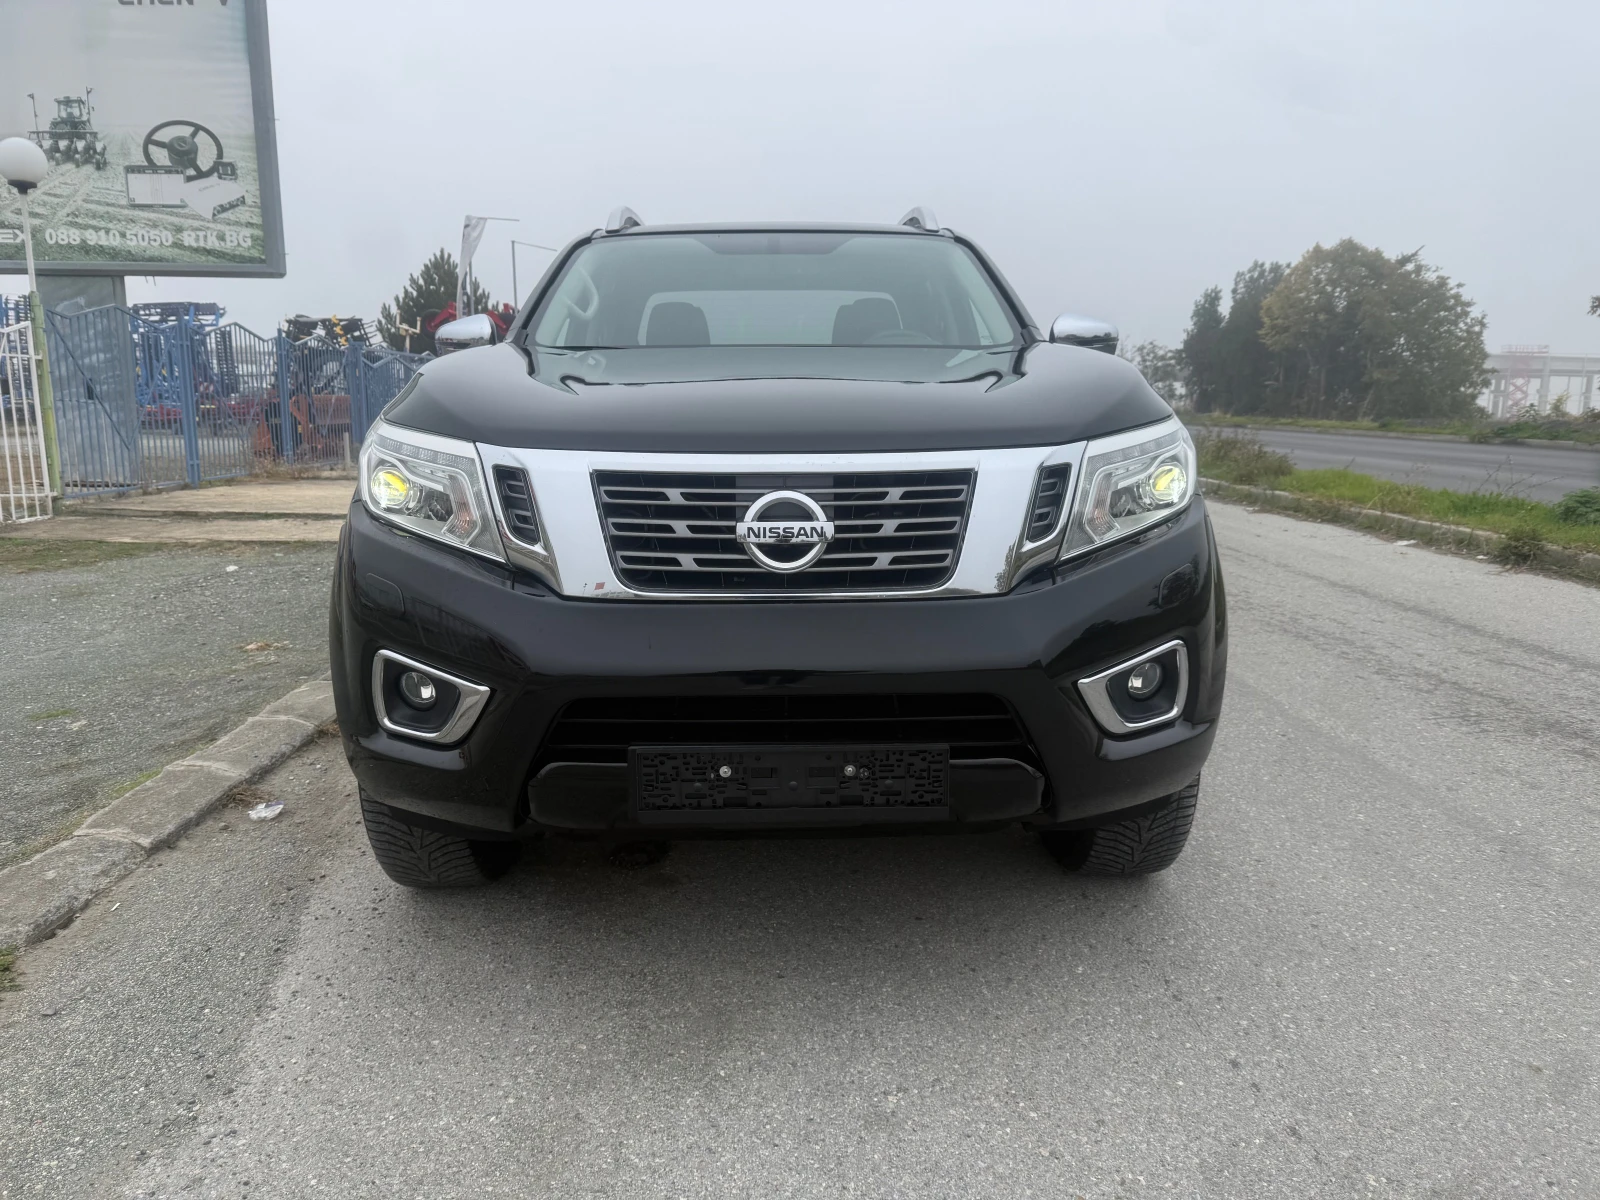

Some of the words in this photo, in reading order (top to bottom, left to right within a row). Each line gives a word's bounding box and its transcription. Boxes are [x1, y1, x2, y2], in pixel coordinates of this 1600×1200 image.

[44, 228, 81, 245] 088
[86, 228, 120, 246] 910
[125, 228, 173, 246] 5050
[746, 526, 825, 539] NISSAN
